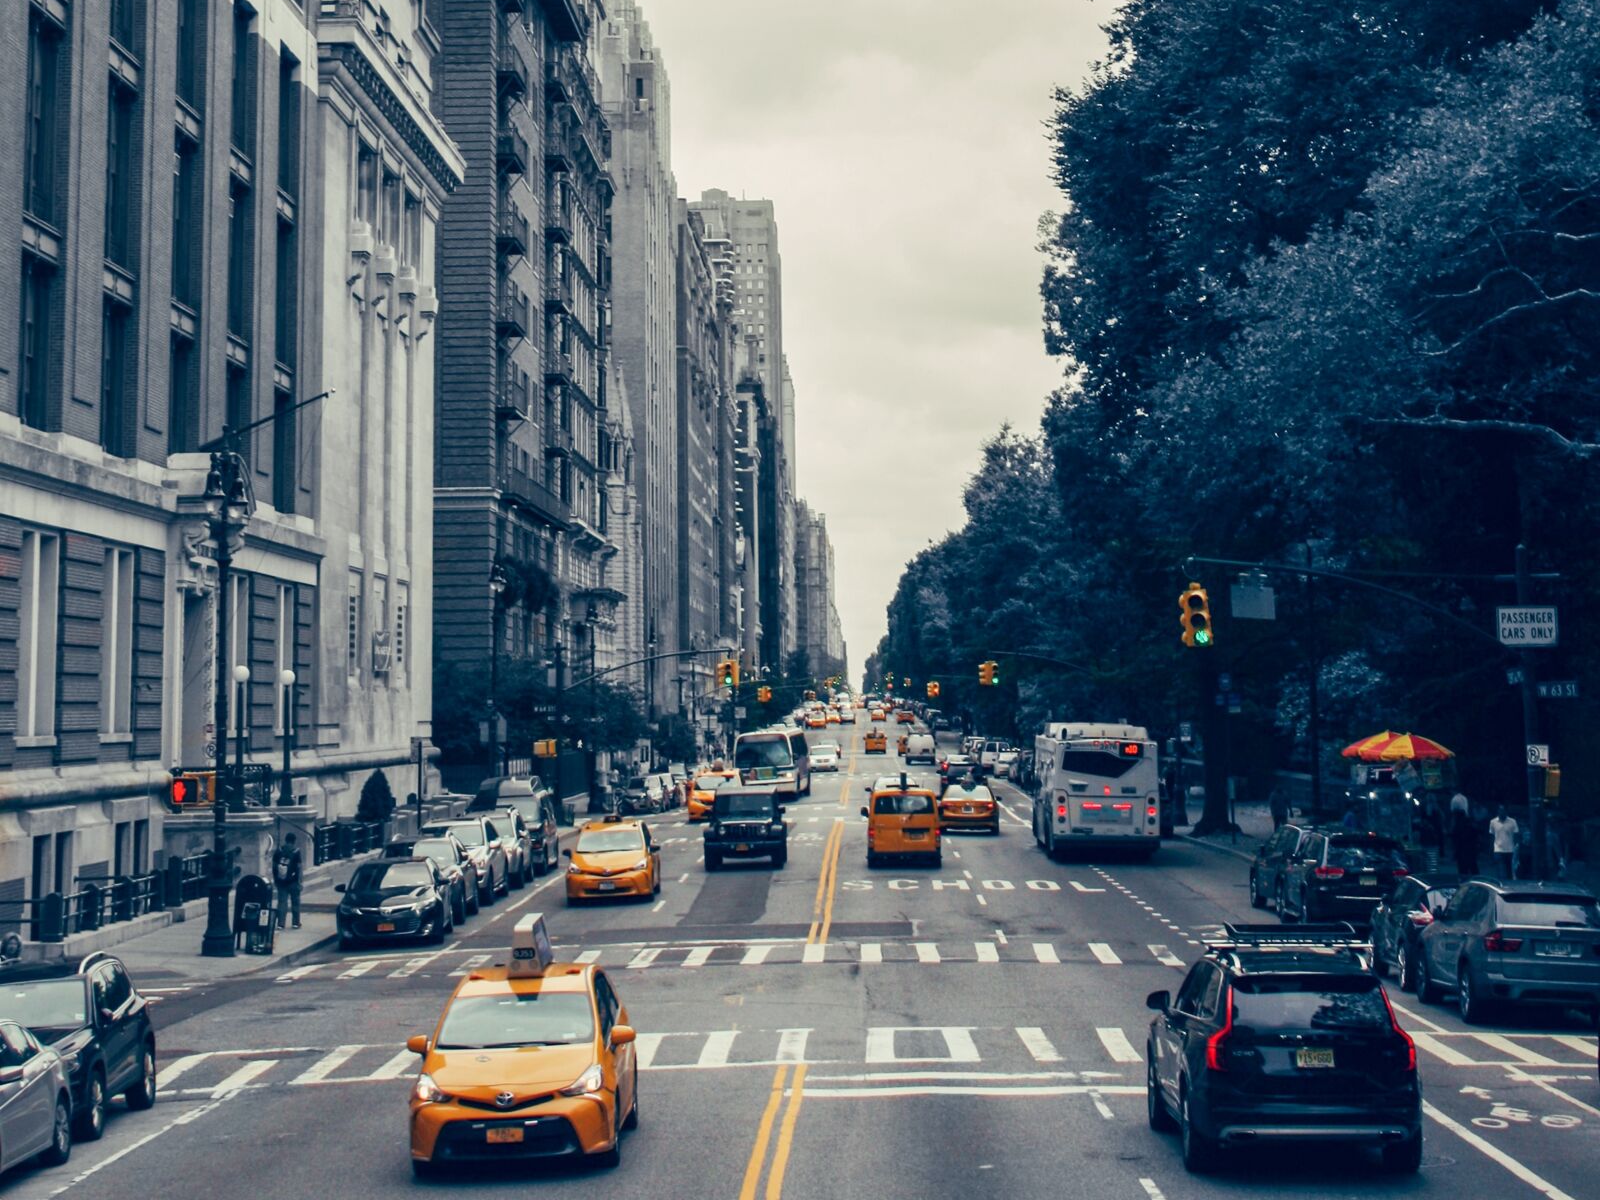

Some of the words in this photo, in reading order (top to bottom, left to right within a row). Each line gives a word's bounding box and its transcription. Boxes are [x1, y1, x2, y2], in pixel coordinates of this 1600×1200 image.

[1501, 611, 1554, 624] PASSENGER
[1501, 627, 1526, 639] CARS
[1530, 627, 1554, 639] ONLY
[1538, 685, 1547, 696] W
[1551, 684, 1562, 697] 63
[841, 879, 1106, 892] SCHOOL
